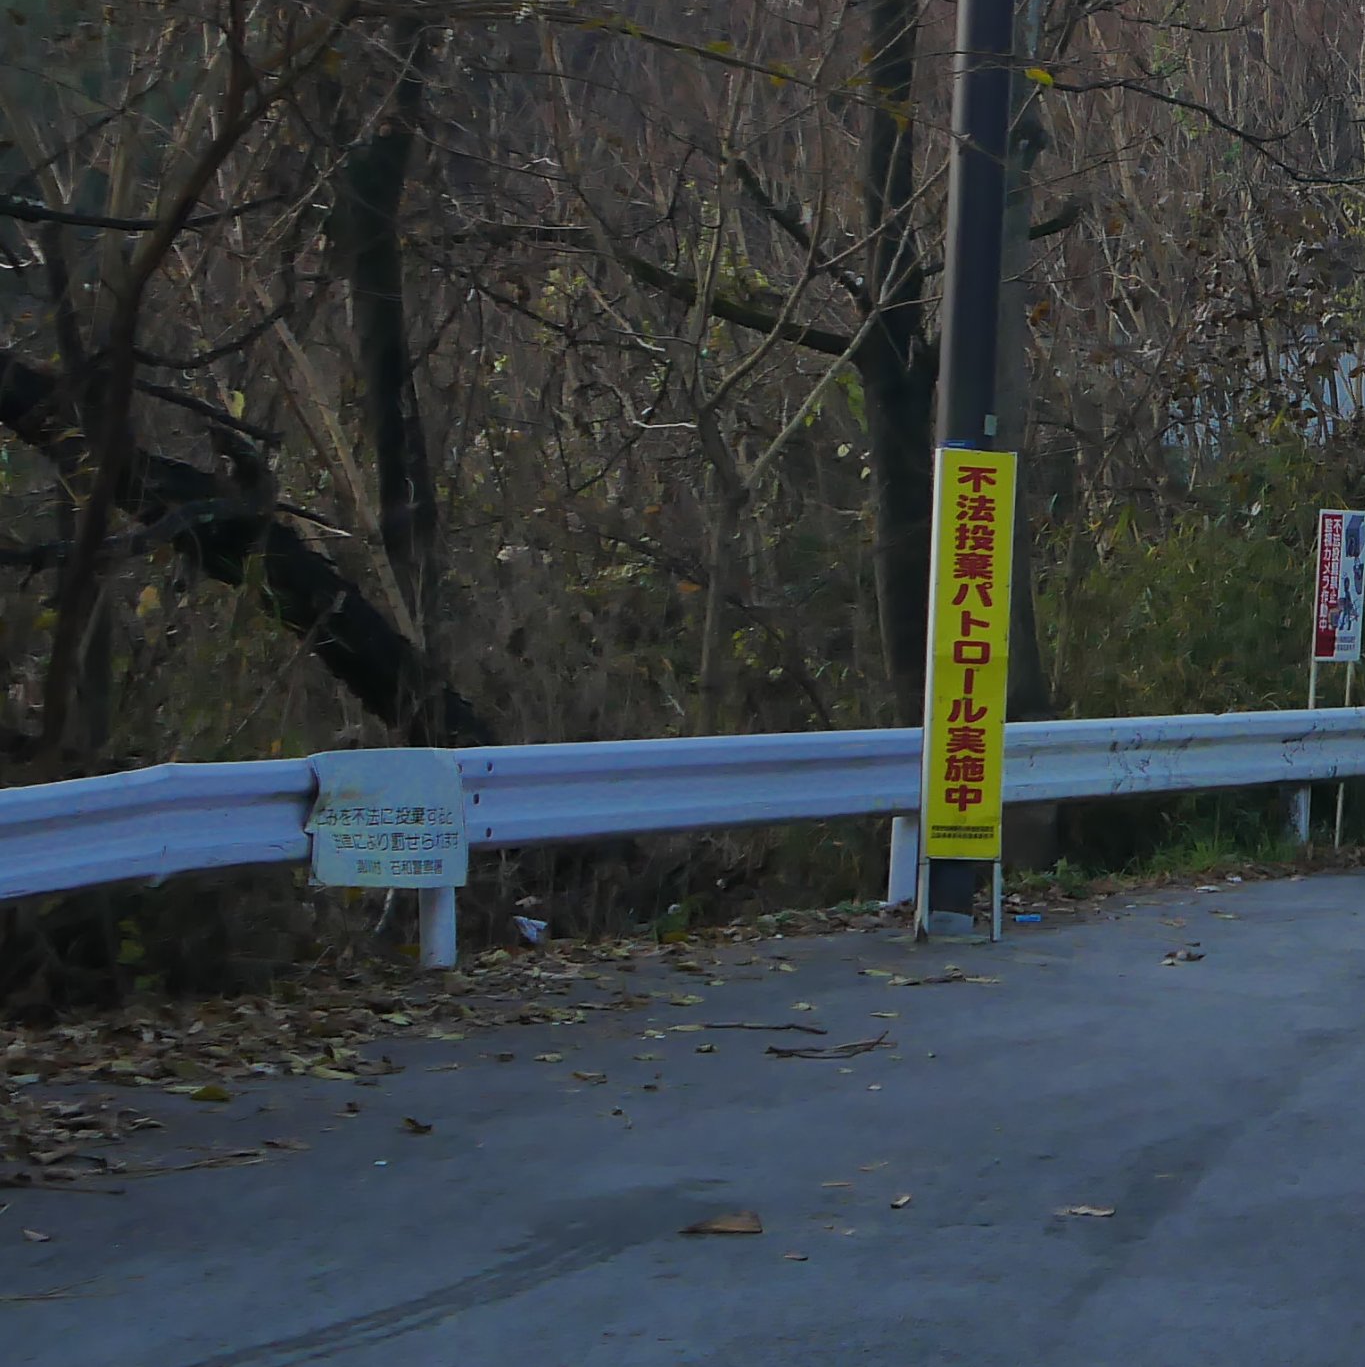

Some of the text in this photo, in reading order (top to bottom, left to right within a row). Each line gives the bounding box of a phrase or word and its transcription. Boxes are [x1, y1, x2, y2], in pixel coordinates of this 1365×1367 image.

[1318, 518, 1333, 632] 監視カメラ作動中
[1329, 518, 1343, 604] 不法投棄禁止
[943, 465, 998, 813] 不法投棄パトロール実施中
